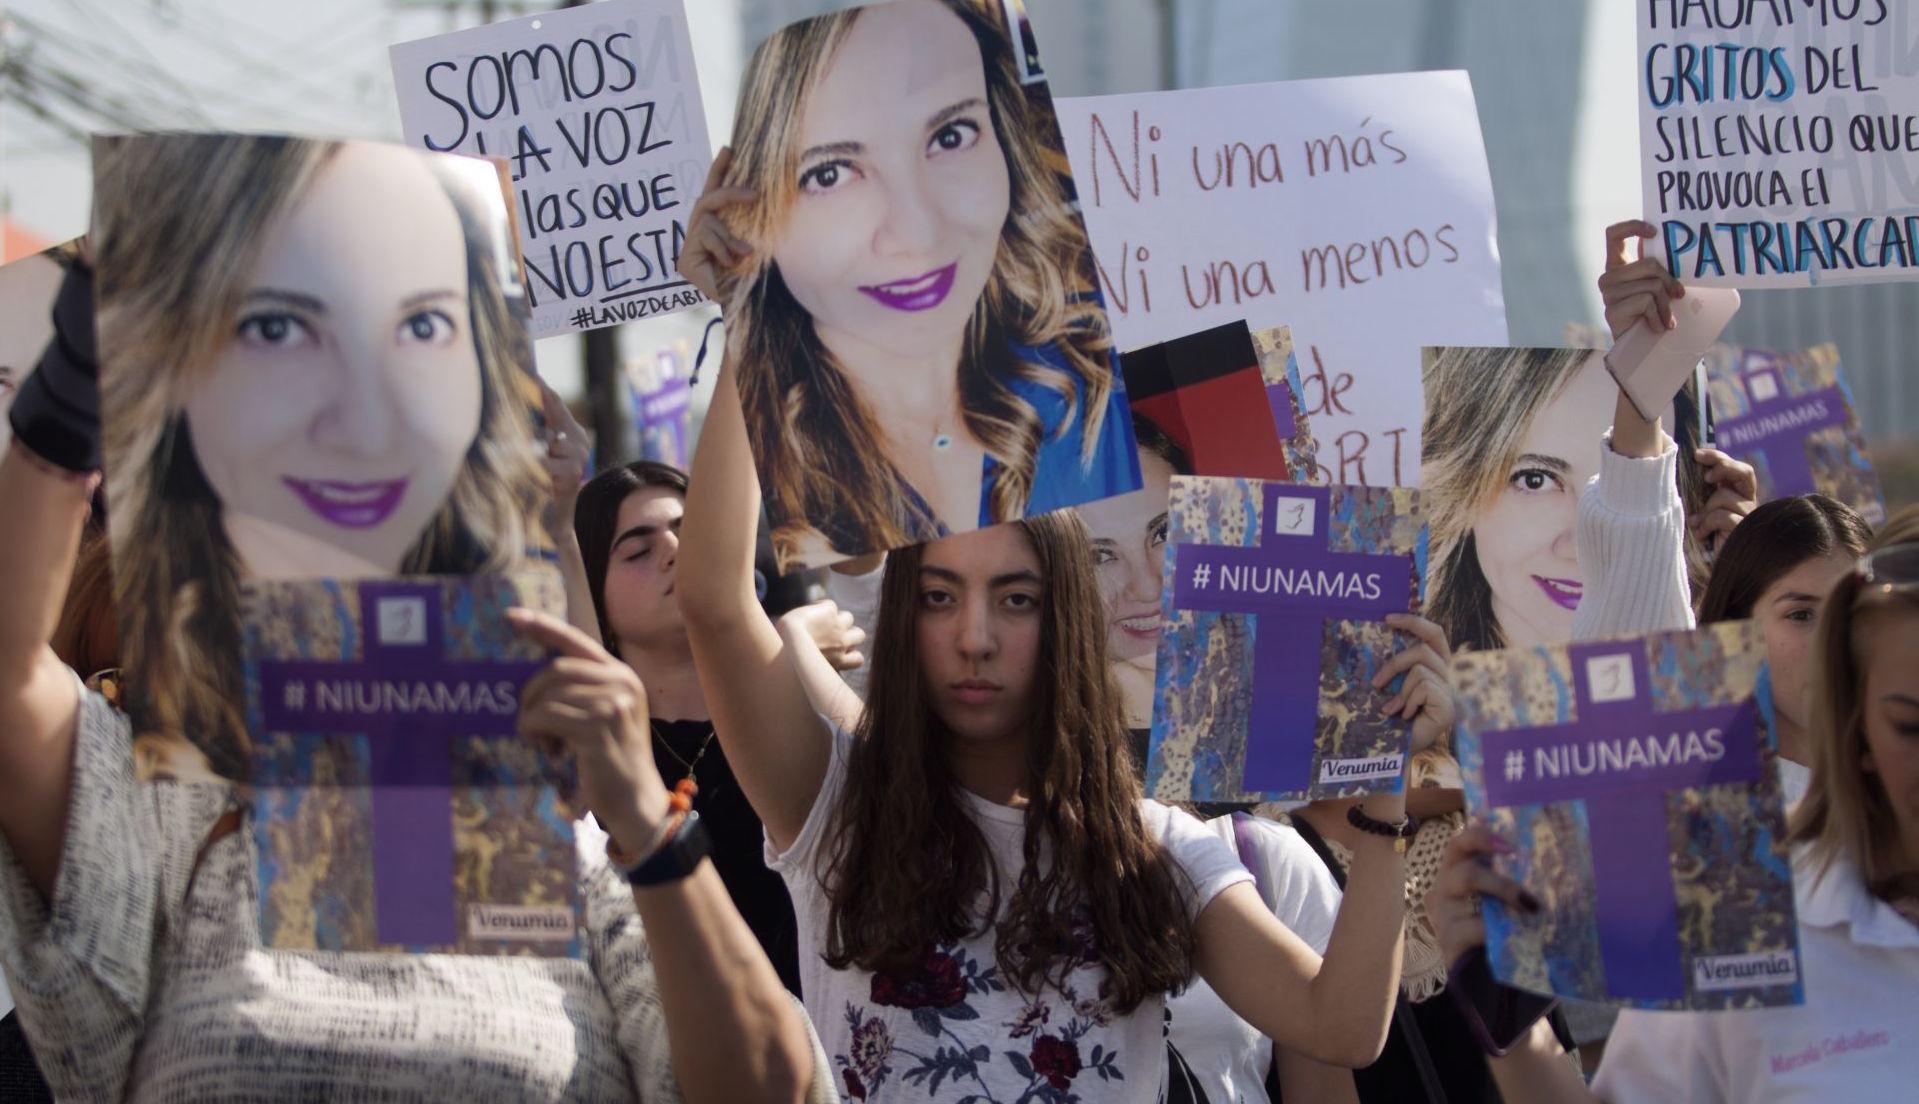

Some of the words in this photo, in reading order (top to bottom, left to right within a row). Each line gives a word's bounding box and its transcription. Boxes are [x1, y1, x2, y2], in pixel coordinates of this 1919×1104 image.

[424, 33, 636, 151] SOMOS
[1646, 43, 1795, 109] GRITOS
[1805, 44, 1878, 94] DEL
[556, 102, 673, 168] VOZ
[1091, 111, 1161, 207] Ni
[1192, 141, 1284, 191] una
[1305, 117, 1407, 177] más
[1655, 114, 1834, 163] SILENCIO
[1850, 114, 1919, 153] QUE
[1657, 170, 1793, 213] PROVOCA
[1182, 258, 1275, 310] una
[1302, 224, 1459, 292] menos
[1303, 345, 1355, 416] de
[1193, 563, 1211, 589] #
[1219, 565, 1381, 599] NIUNAMAS
[284, 680, 307, 711] #
[315, 679, 519, 715] NIUNAMAS
[1322, 757, 1399, 776] Venumia
[1504, 750, 1524, 782] #
[1534, 728, 1725, 779] NIUNAMAS
[472, 908, 569, 928] Venumia
[1696, 953, 1793, 979] Venumia
